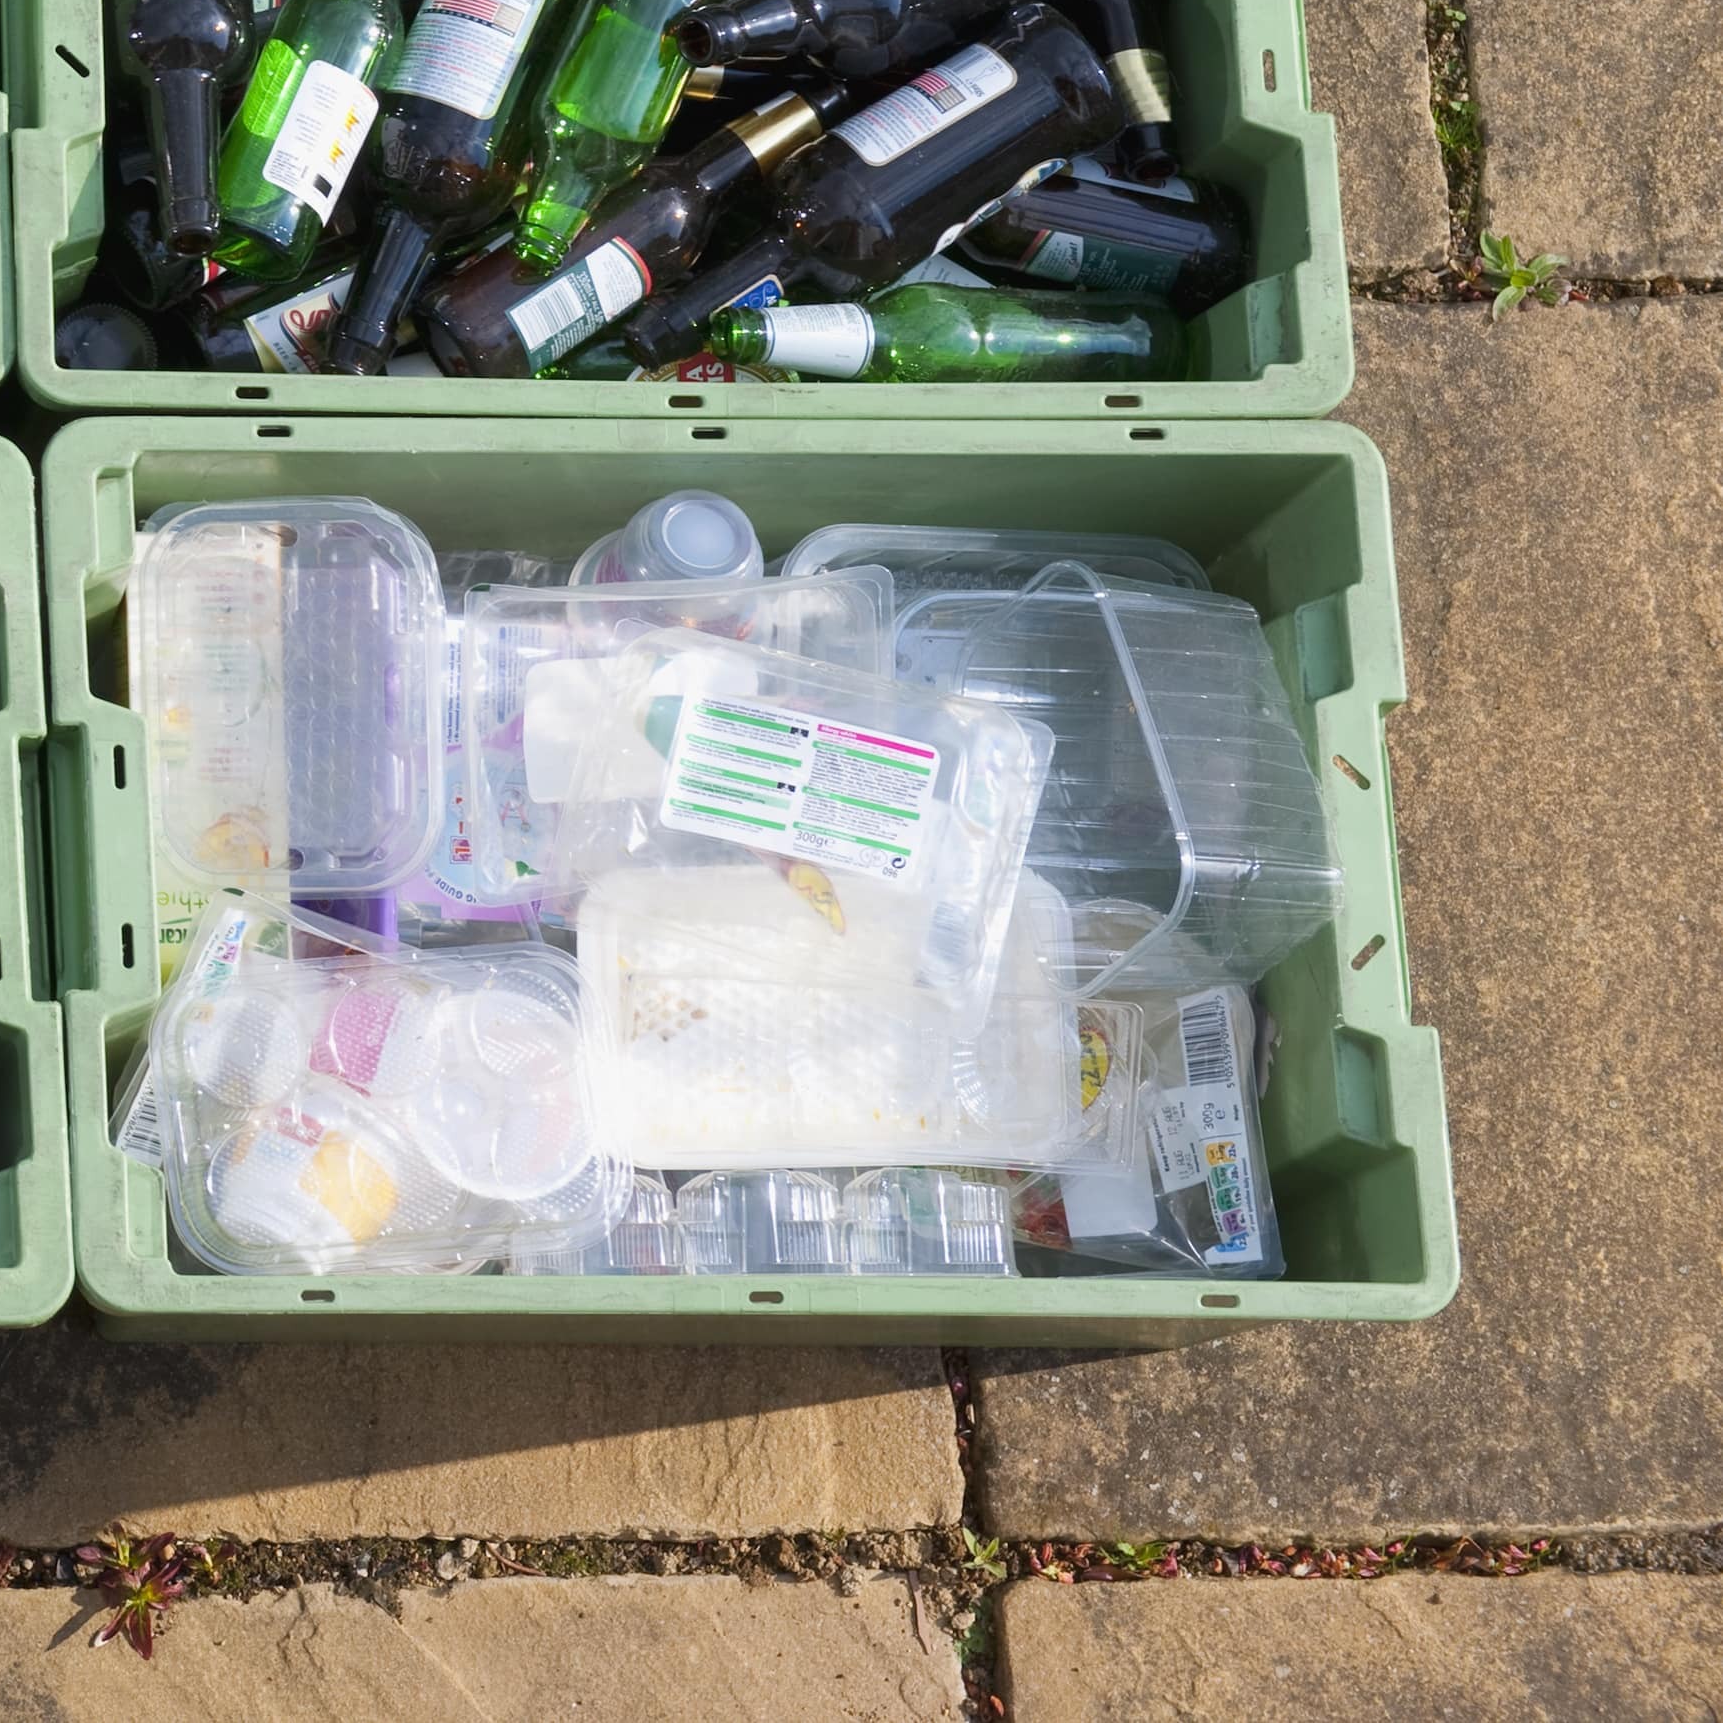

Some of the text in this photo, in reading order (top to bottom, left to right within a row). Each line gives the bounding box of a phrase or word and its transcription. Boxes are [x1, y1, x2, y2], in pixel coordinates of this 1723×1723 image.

[794, 830, 826, 848] 300g
[1201, 1101, 1214, 1131] 300g
[1161, 1154, 1170, 1172] Keep
[1173, 1149, 1186, 1166] AUG
